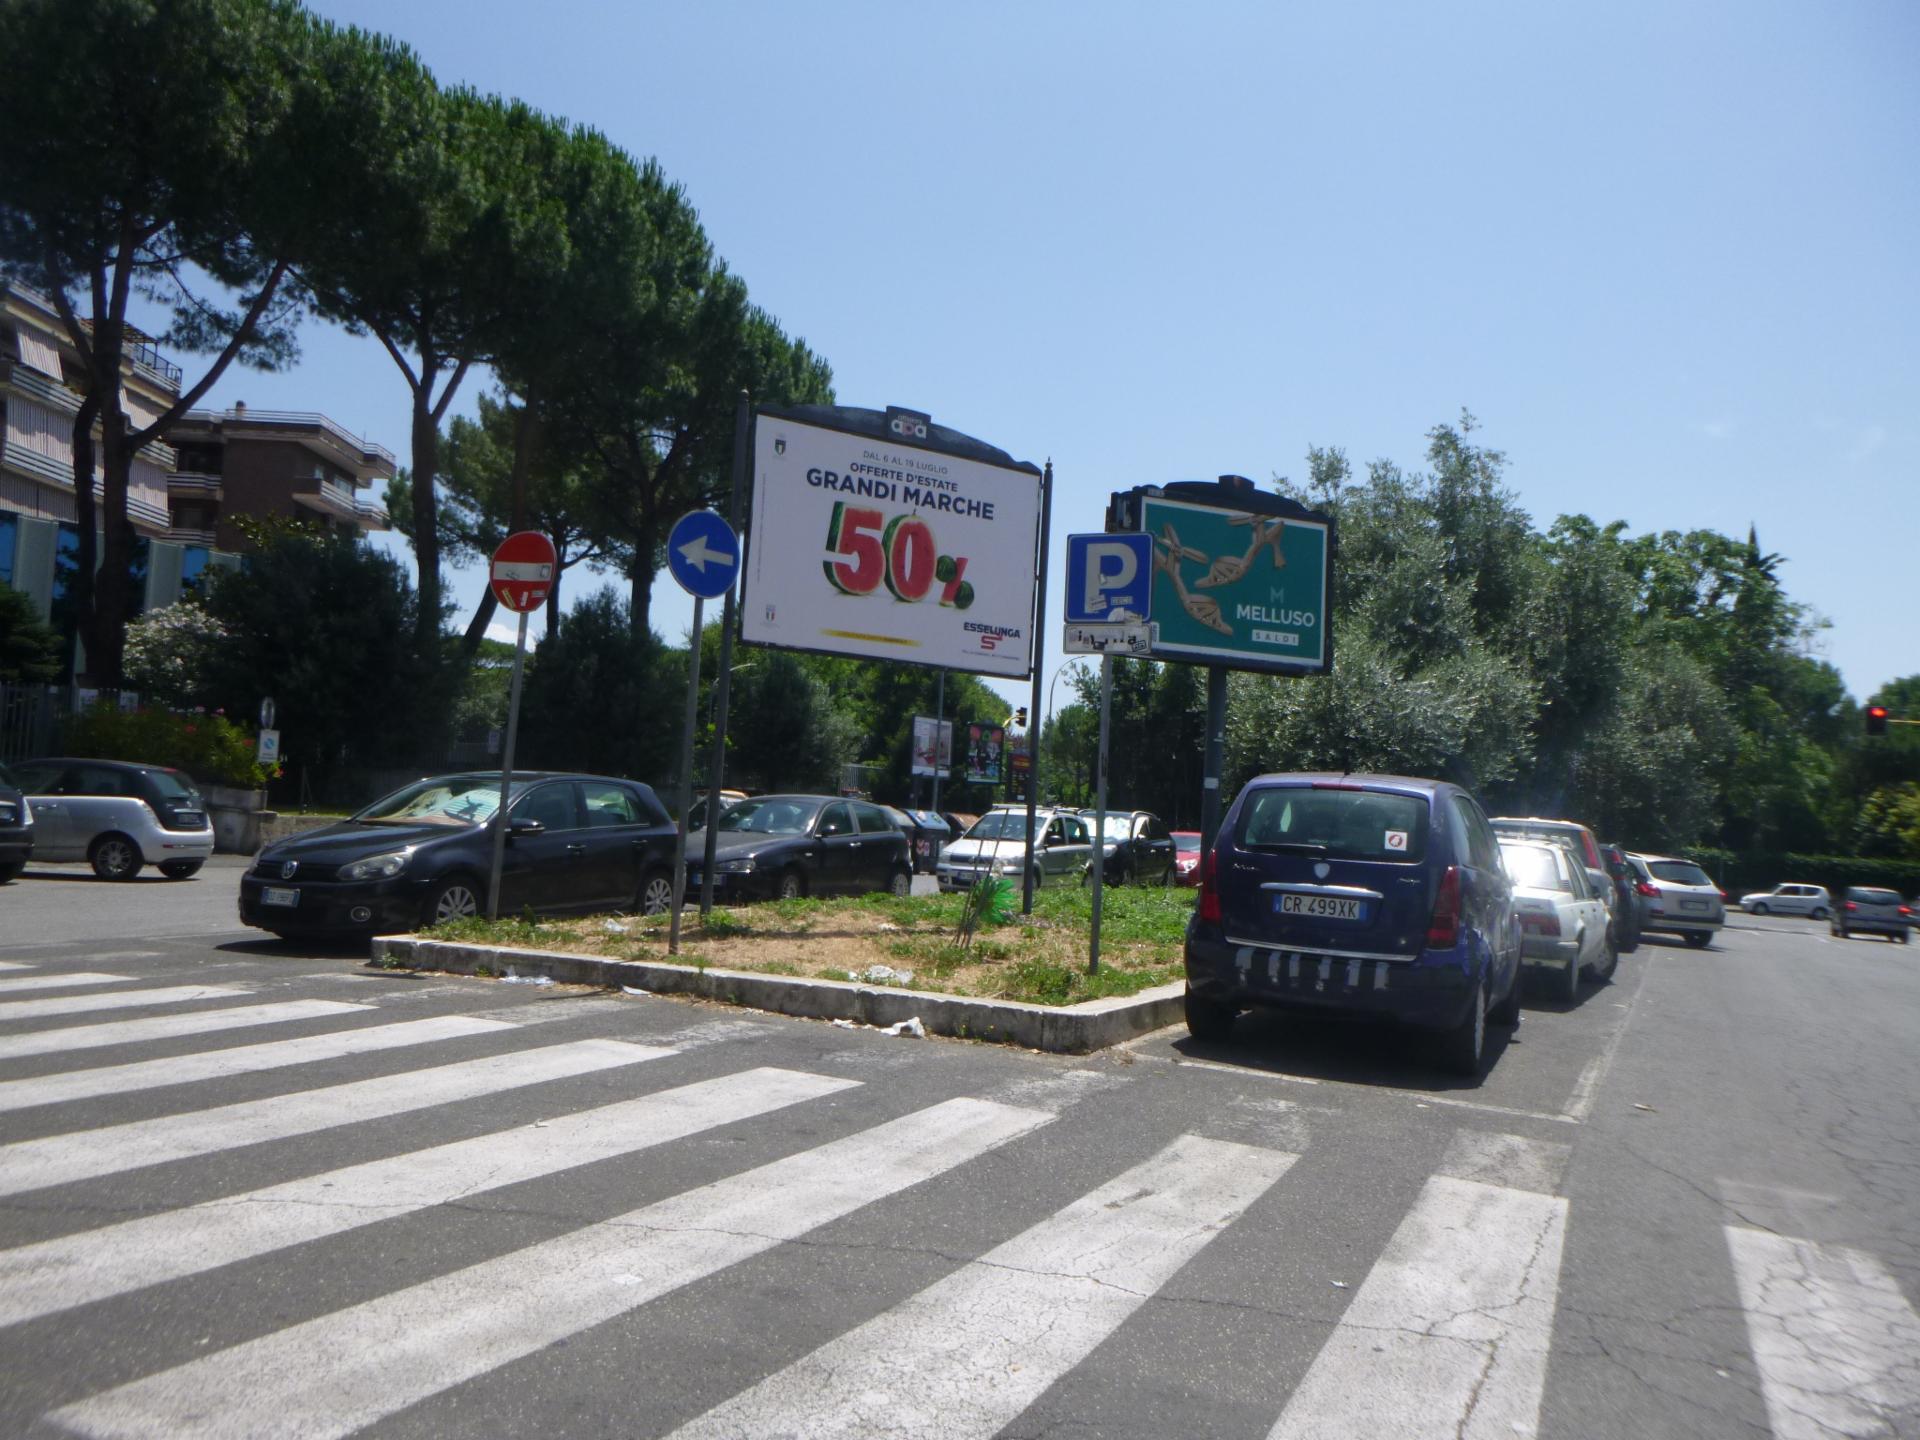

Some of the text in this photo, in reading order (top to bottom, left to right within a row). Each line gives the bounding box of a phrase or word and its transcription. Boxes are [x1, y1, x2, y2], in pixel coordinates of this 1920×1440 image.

[850, 462, 959, 492] OFFERTE D'ESTATE
[863, 450, 881, 462] DAL
[891, 457, 903, 466] AL
[905, 459, 914, 467] 19
[916, 461, 948, 475] LUGLIO
[806, 468, 994, 520] GRANDI MARCHE
[823, 501, 975, 610] 50%
[1084, 542, 1138, 614] P
[963, 621, 1021, 639] ESSELUNGA
[1236, 604, 1315, 628] MELLUSO
